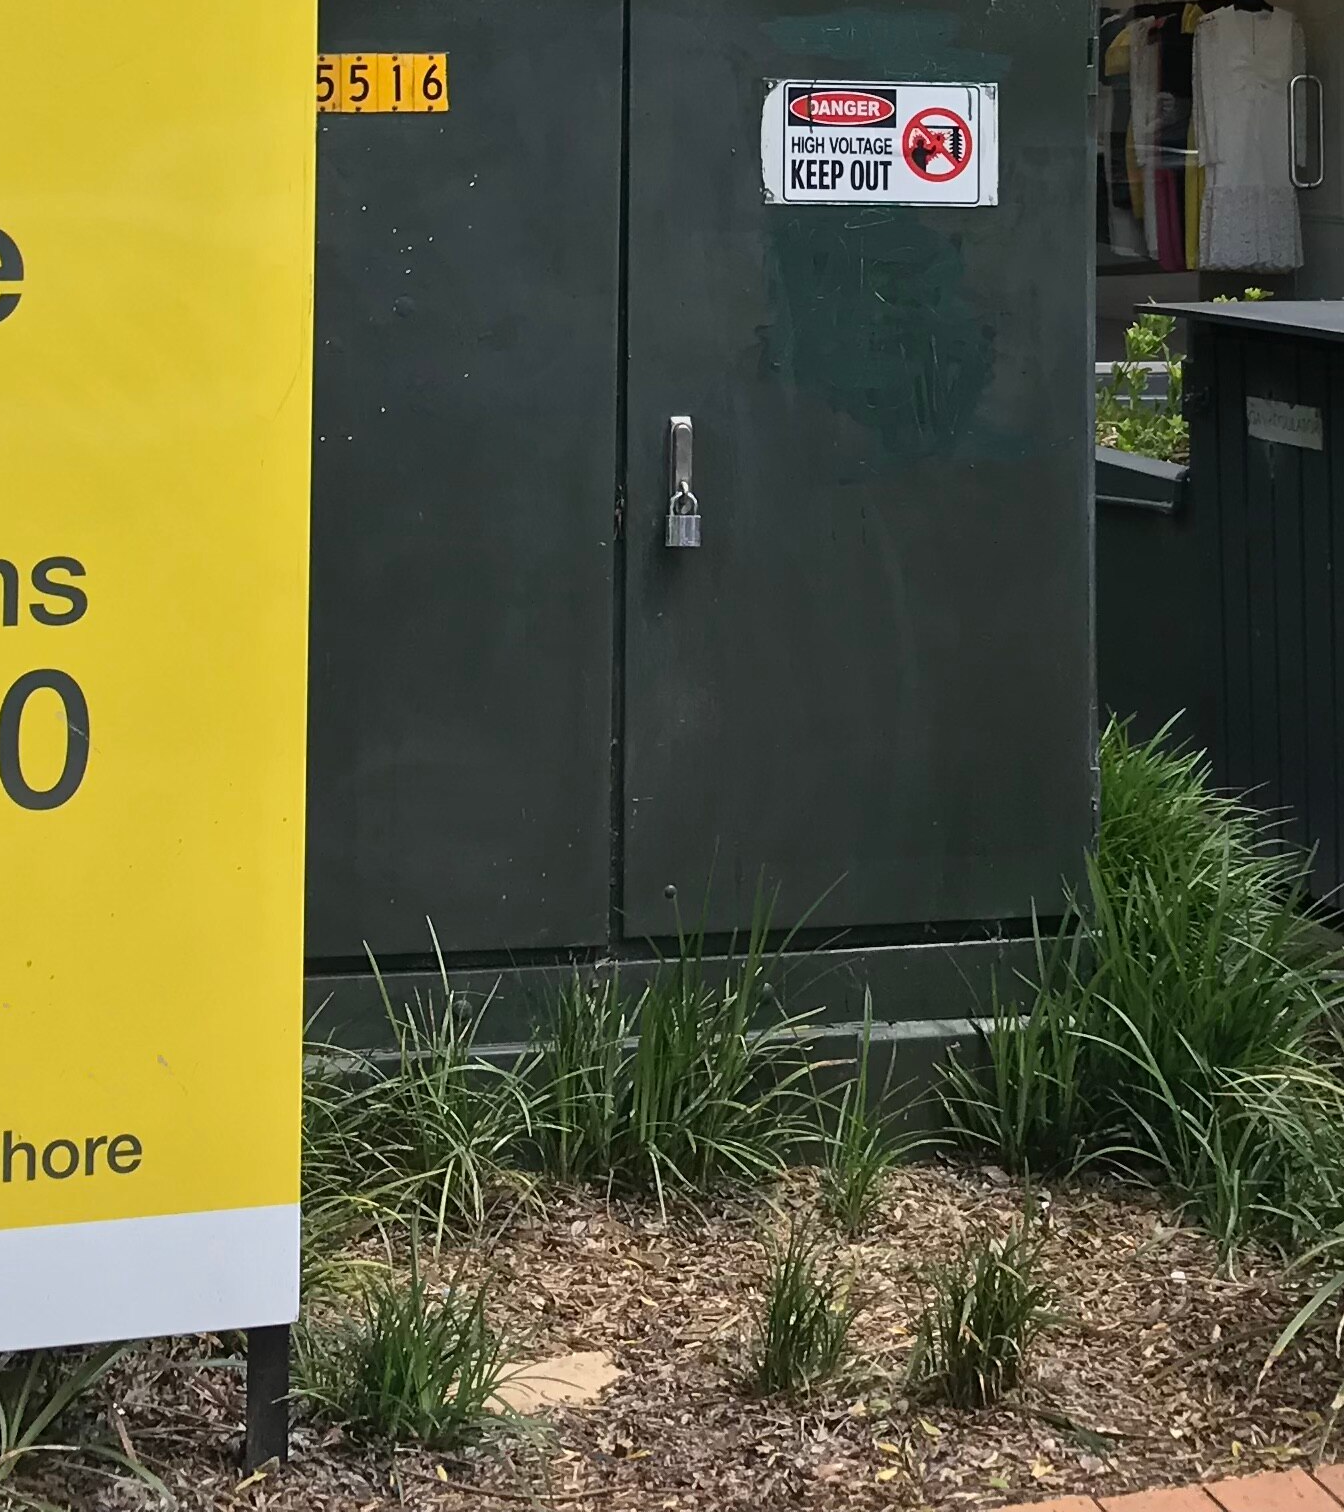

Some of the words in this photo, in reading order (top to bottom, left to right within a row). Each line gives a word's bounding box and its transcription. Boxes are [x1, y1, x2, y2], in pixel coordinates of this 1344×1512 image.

[807, 99, 881, 117] DANGER
[791, 136, 824, 155] HIGH
[829, 136, 893, 156] VOLTAGE
[790, 158, 844, 191] KEEP
[850, 159, 893, 191] OUT
